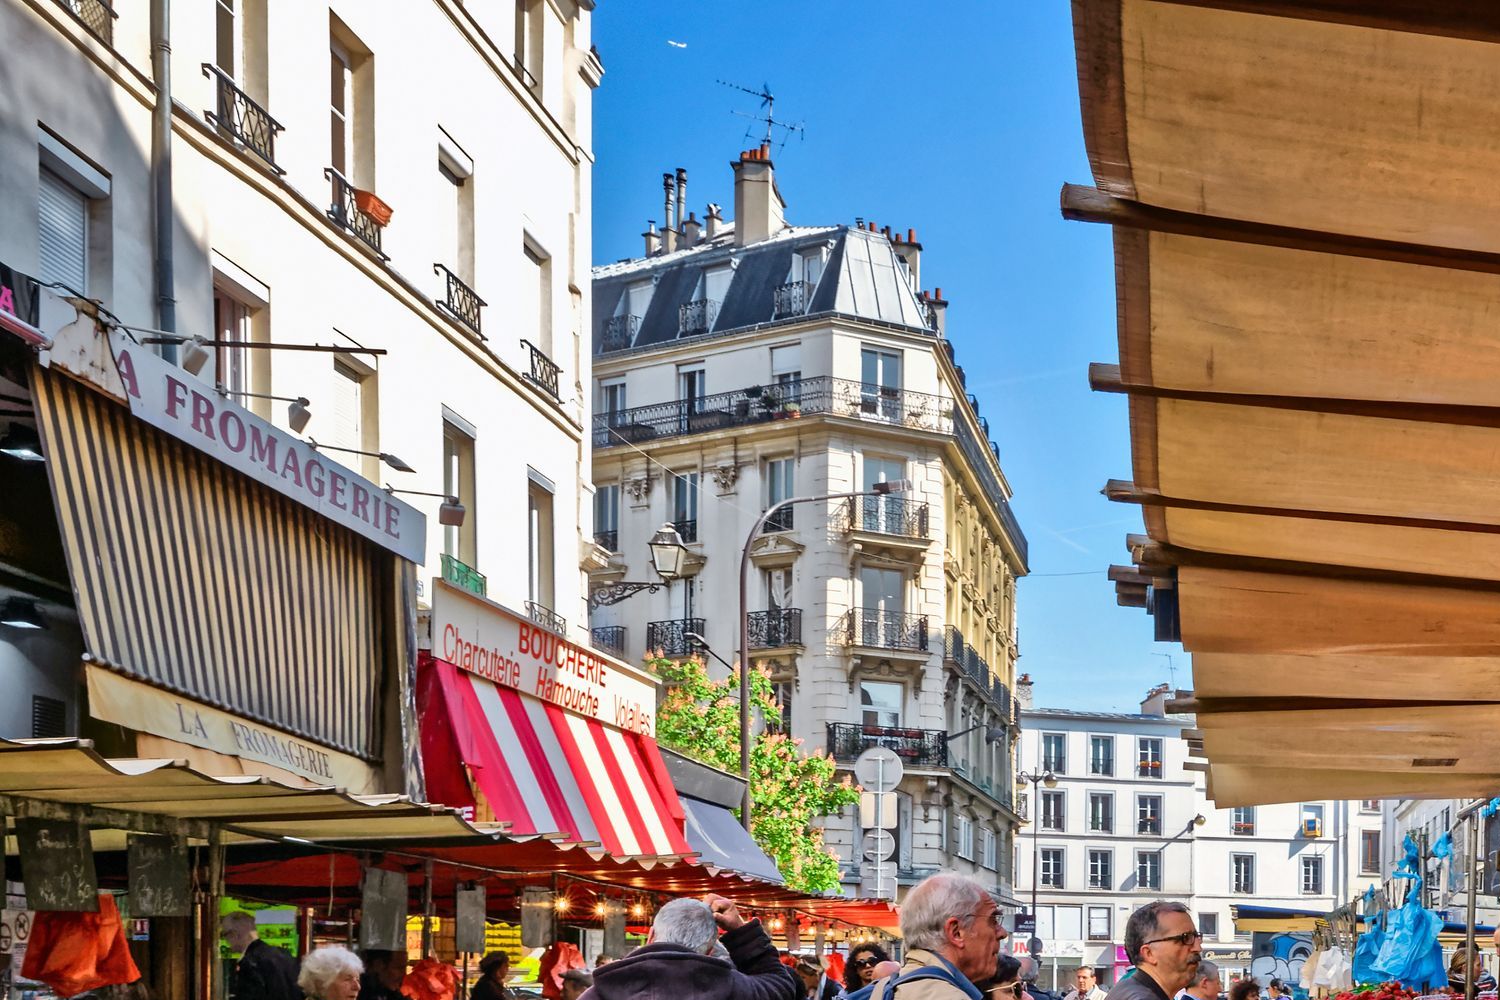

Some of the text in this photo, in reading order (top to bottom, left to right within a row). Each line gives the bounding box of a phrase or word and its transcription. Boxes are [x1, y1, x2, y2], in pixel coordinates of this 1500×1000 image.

[115, 349, 401, 540] A FROMAGERIE
[443, 623, 651, 736] Charcuterie Hamouche Volailles
[518, 622, 608, 688] BOUCHERIE
[176, 702, 333, 779] LA FROMAGERIE
